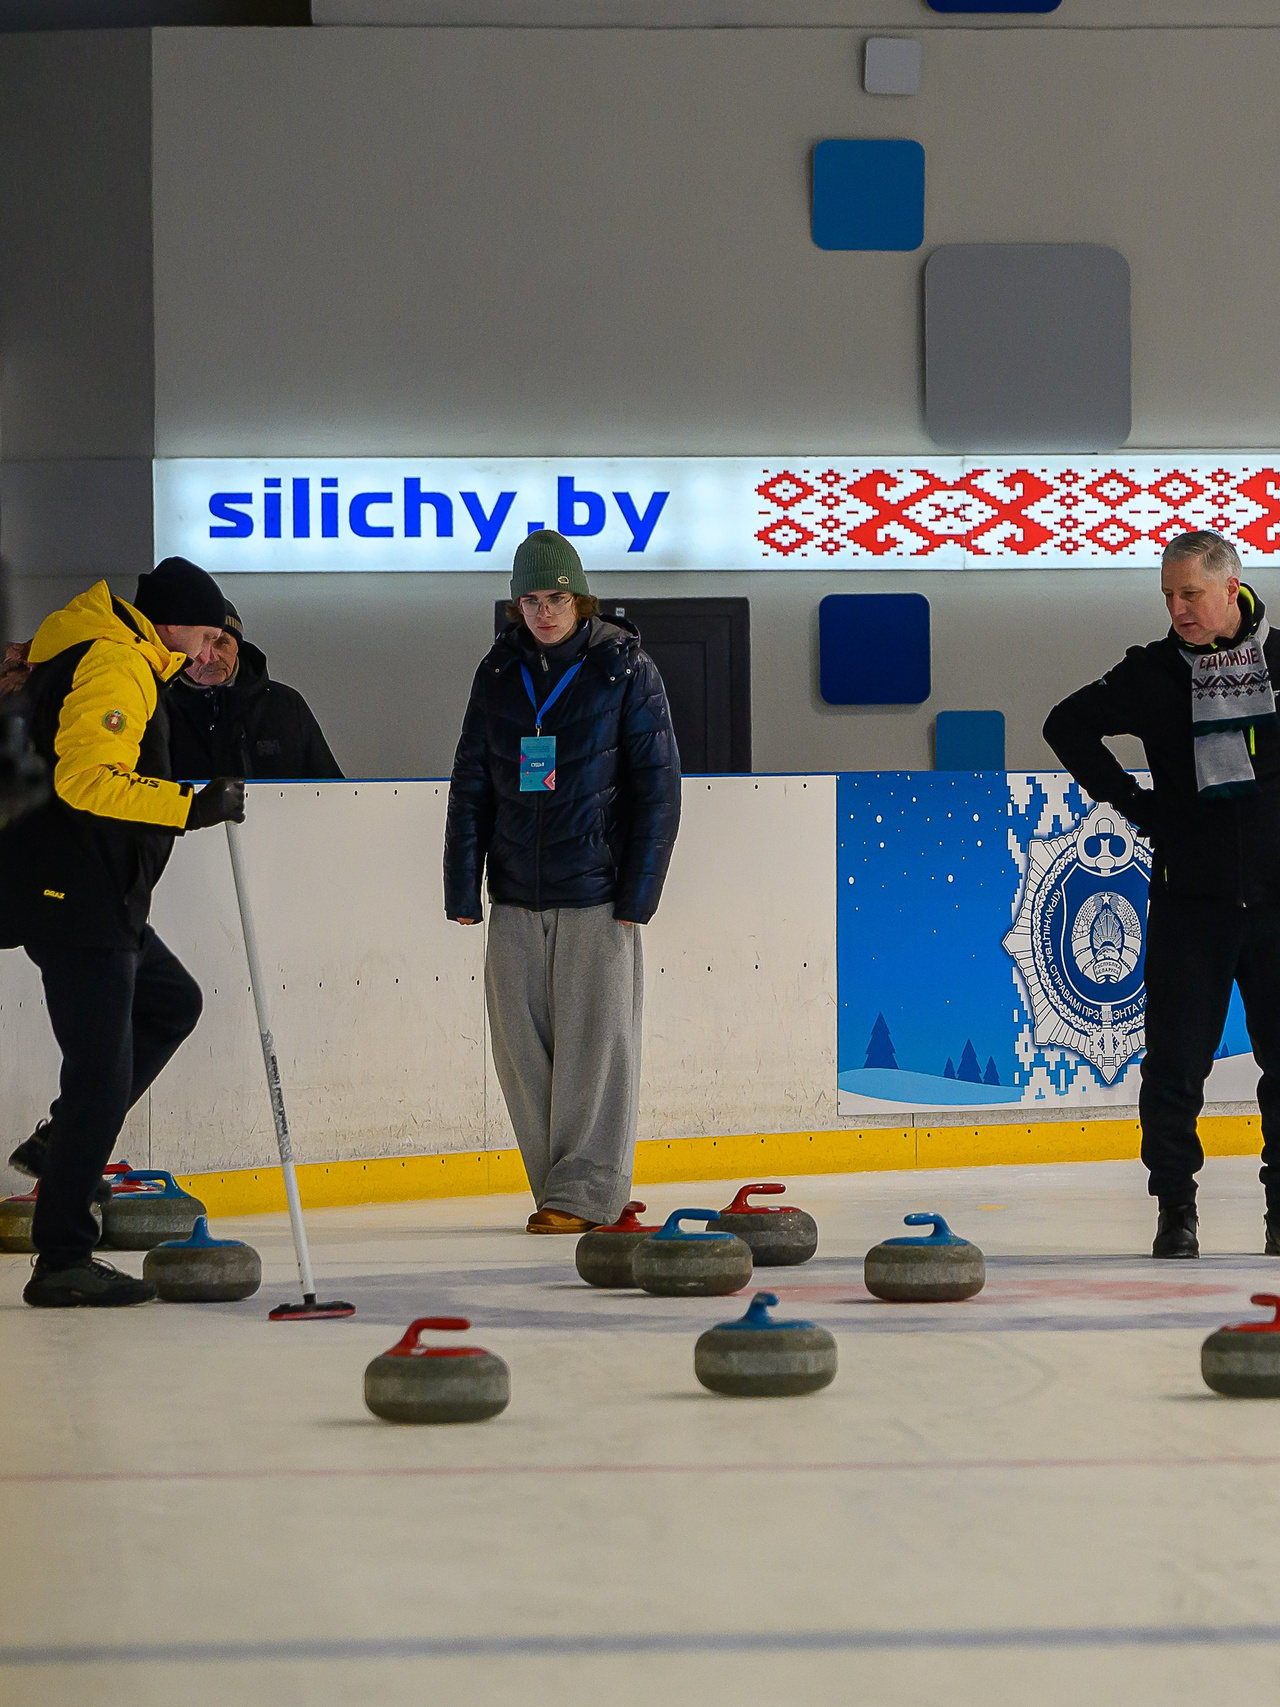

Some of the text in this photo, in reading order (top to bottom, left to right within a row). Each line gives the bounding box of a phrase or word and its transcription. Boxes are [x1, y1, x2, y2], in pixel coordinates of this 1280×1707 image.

[208, 475, 670, 553] silichy.by
[1199, 648, 1259, 671] ЕДИНЫЕ
[1050, 964, 1082, 1011] СПРАВАМІ
